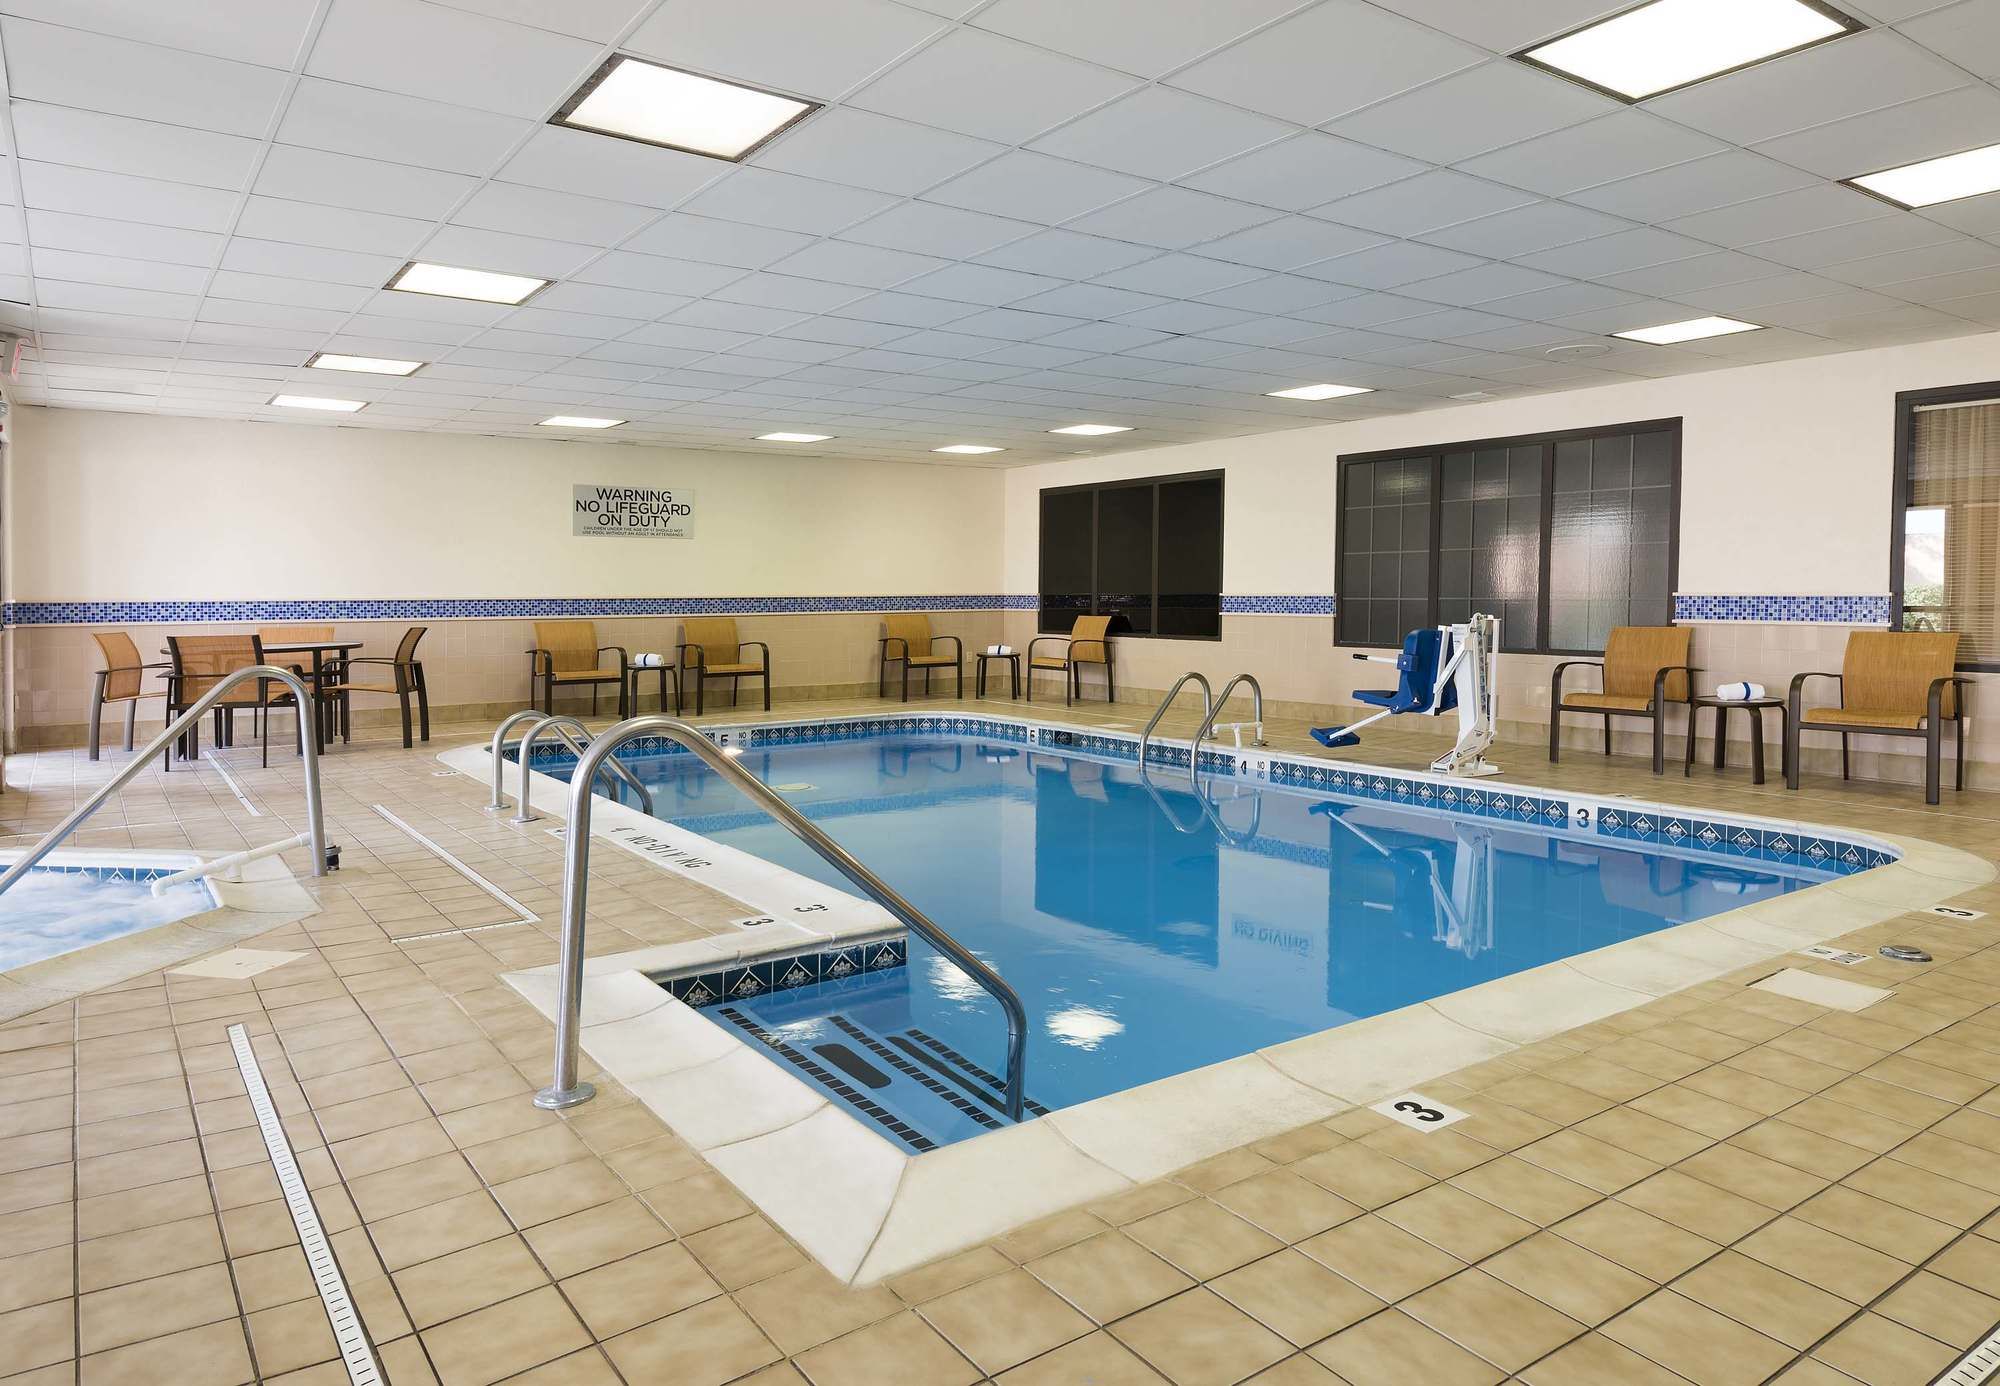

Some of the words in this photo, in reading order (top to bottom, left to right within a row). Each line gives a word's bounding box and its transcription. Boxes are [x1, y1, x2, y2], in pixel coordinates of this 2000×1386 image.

[596, 487, 672, 503] WARNING
[575, 500, 600, 513] NO
[606, 501, 691, 516] LIFEGUARD
[598, 513, 622, 526] ON
[629, 515, 671, 528] DUTY
[1577, 808, 1589, 827] 3
[1934, 906, 1974, 917] 3
[743, 918, 775, 926] 3
[1394, 1101, 1445, 1122] 3
